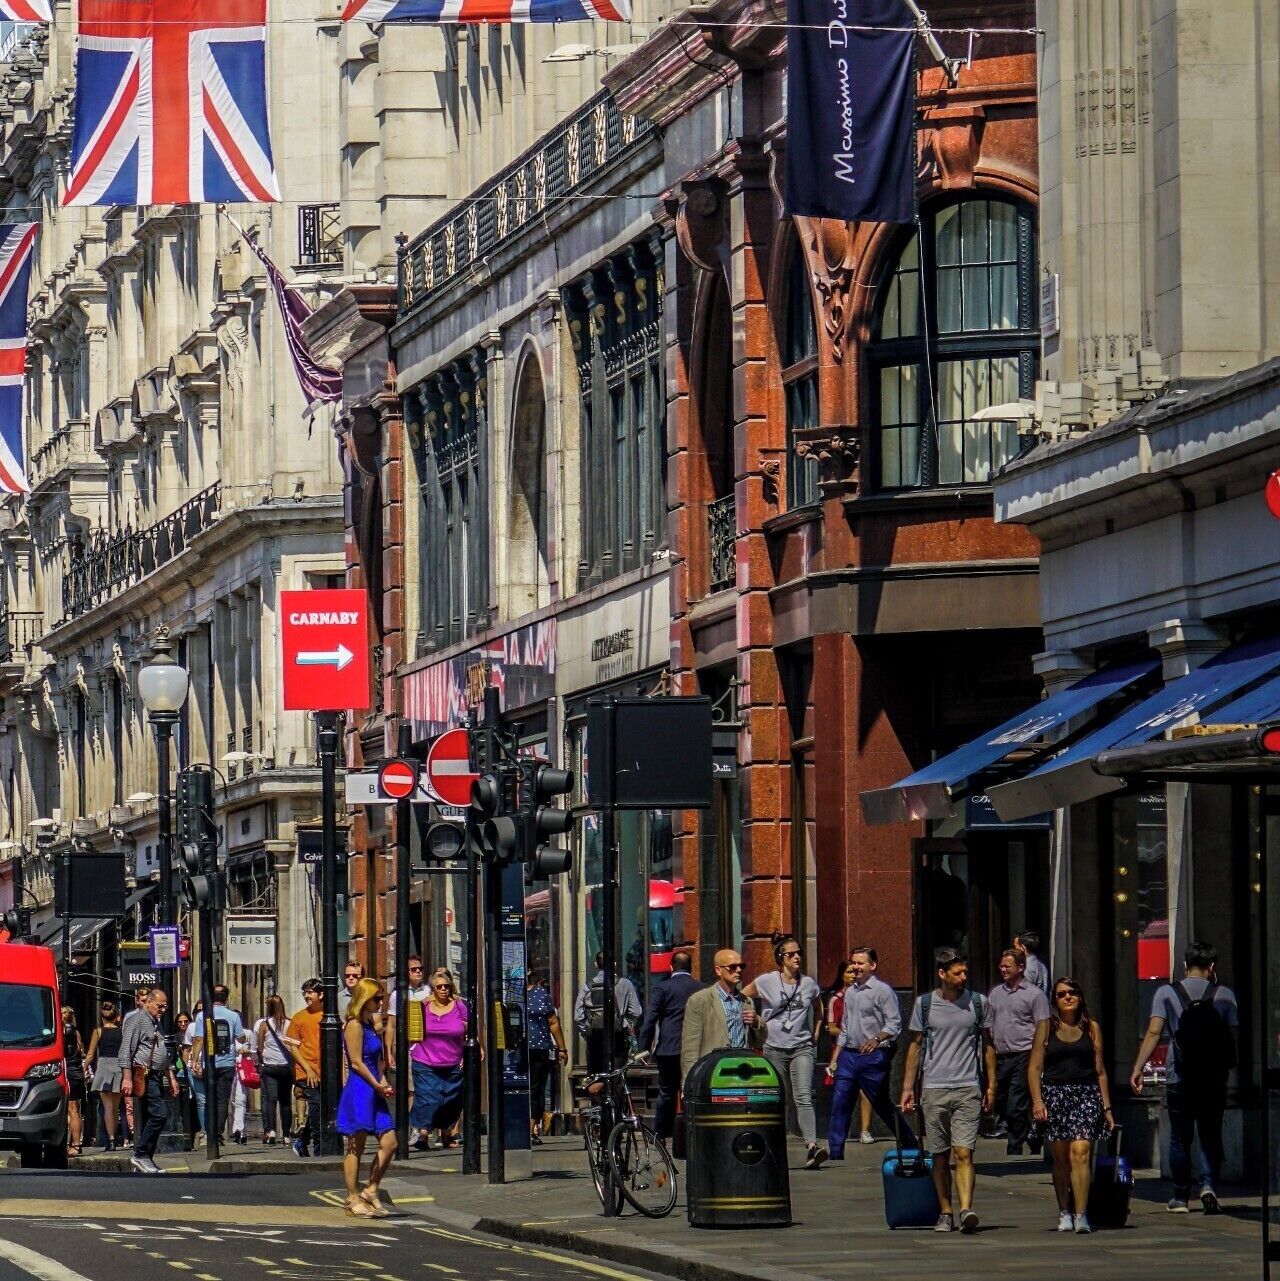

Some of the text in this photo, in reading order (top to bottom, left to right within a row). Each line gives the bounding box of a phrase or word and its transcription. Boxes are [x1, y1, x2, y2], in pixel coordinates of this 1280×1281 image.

[832, 58, 855, 184] Massimo
[289, 611, 359, 626] CARNABY
[230, 936, 272, 945] REISS
[129, 972, 156, 982] BOSS
